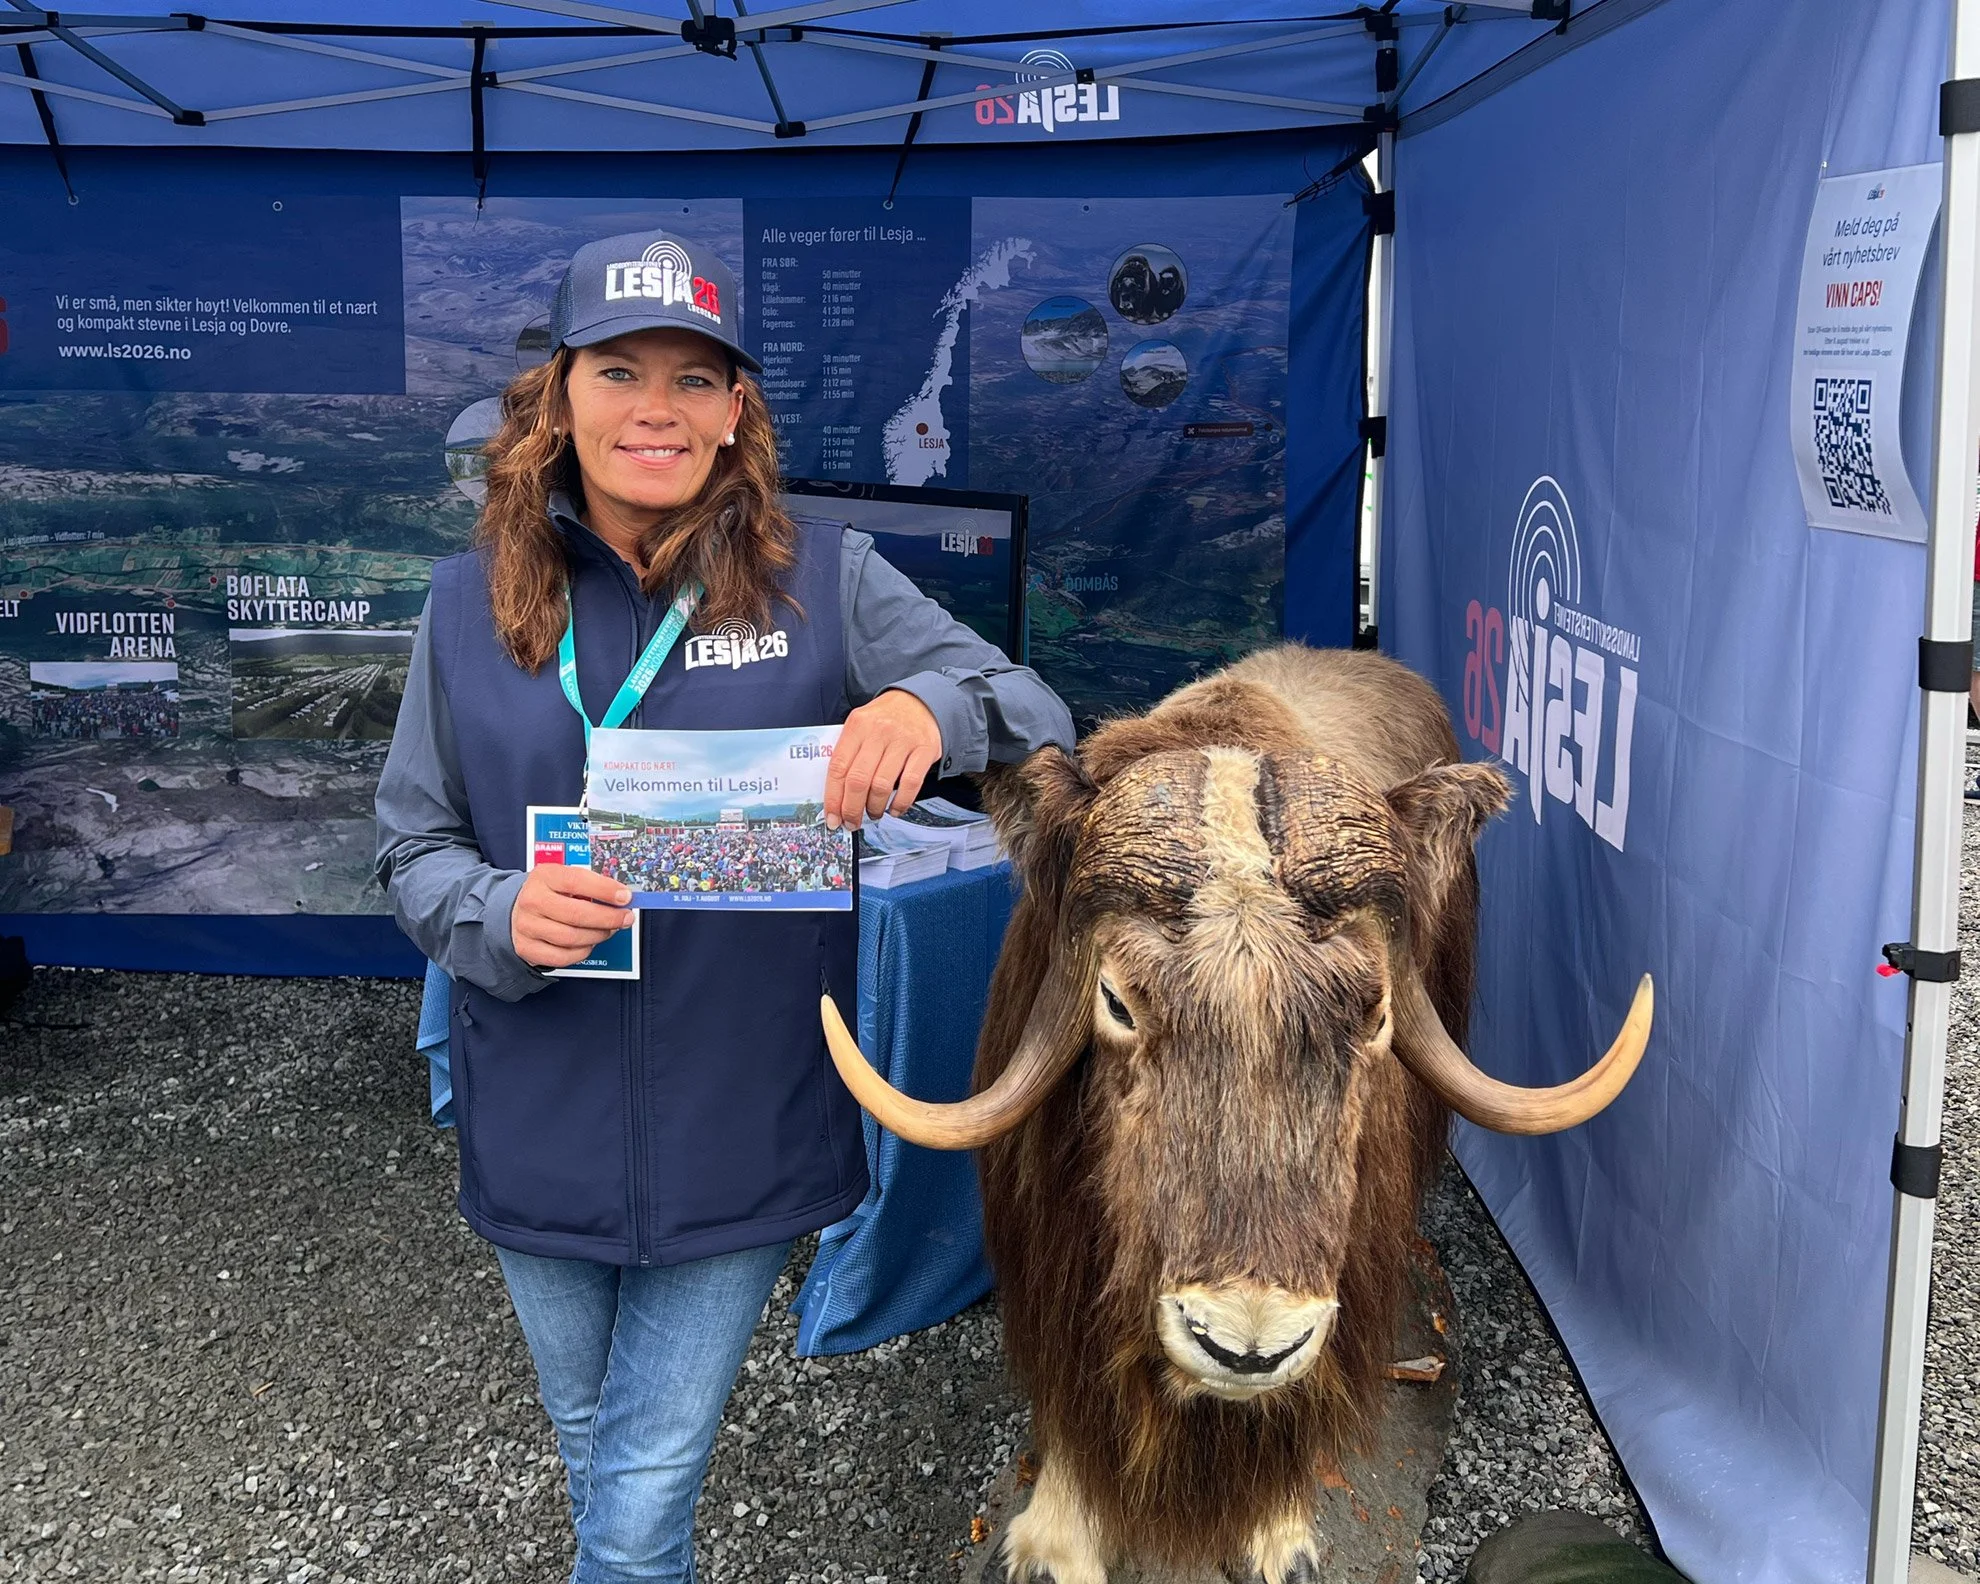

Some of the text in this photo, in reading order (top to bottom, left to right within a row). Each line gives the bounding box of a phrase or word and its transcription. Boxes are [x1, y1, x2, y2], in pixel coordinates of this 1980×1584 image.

[1834, 211, 1901, 238] Meld deg på
[762, 228, 786, 243] Alle
[789, 230, 826, 246] veger
[830, 227, 860, 243] fører
[864, 226, 876, 241] til
[880, 226, 913, 244] Lesja
[1823, 243, 1901, 269] vårt nyhetsbrev
[762, 257, 799, 268] FRA SØR:
[822, 270, 831, 279] 50
[832, 270, 861, 279] minutter
[822, 282, 831, 291] 40
[832, 281, 861, 291] minutter
[840, 294, 853, 302] min
[1826, 280, 1883, 308] VINN CAPS!
[55, 294, 378, 316] Vi er små, men sikter høyt! Velkommen til et nært
[841, 306, 854, 314] min
[57, 314, 292, 336] og kompakt stevne i Lesja og Dovre.
[841, 318, 854, 326] min
[58, 343, 192, 360] www.ls2026.no
[763, 342, 805, 352] FRA NORD:
[832, 354, 861, 363] minutter
[839, 366, 851, 374] min
[840, 378, 853, 386] min
[841, 390, 854, 398] min
[780, 413, 802, 424] VEST:
[823, 425, 861, 434] 40 minutter
[841, 437, 854, 445] min
[918, 437, 945, 449] LESJA
[840, 449, 853, 457] min
[838, 461, 850, 469] min
[226, 574, 310, 598] BØFLATA
[1065, 572, 1119, 592] DOMBÅS
[227, 599, 371, 622] SKYTTERCAMP
[55, 612, 175, 634] VIDFLOTTEN
[110, 636, 176, 658] ARENA
[603, 761, 677, 771] KOMPAKT OG NÆRT
[604, 776, 779, 795] Velkommen til Lesja!
